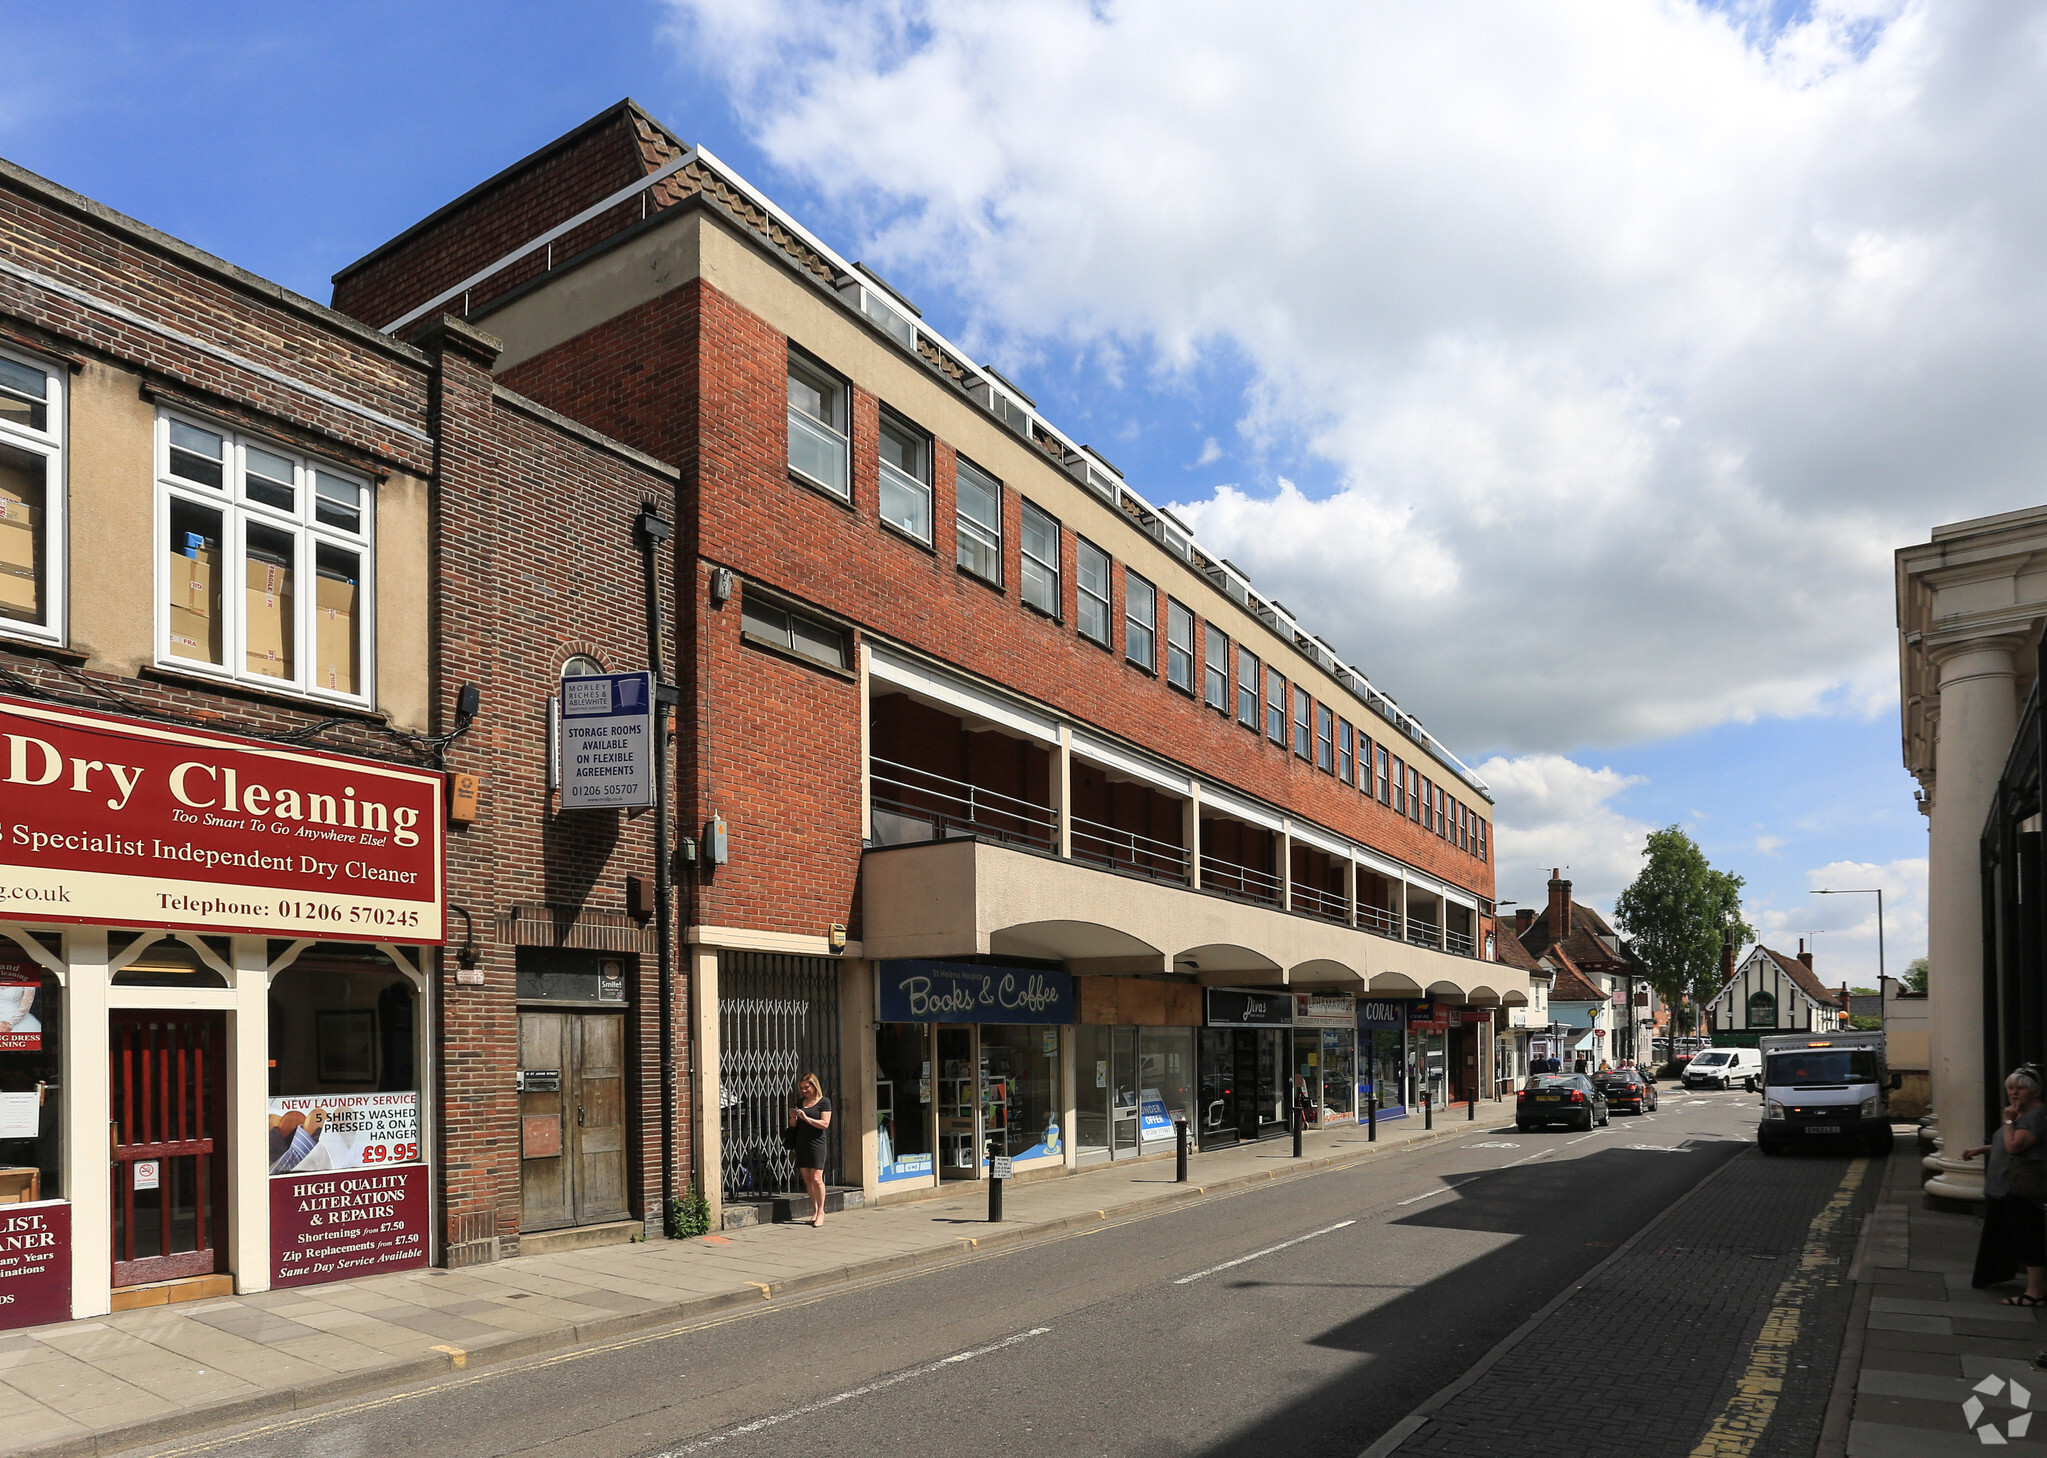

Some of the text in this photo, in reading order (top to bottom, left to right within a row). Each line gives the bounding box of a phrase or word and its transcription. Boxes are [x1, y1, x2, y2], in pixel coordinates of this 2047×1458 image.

[183, 638, 197, 647] FRA
[569, 683, 606, 692] MORLEY
[569, 698, 607, 706] ABLEWHITE
[568, 725, 642, 738] STORAGE ROOMS
[582, 739, 628, 750] AVAILABLE
[576, 752, 634, 764] ON FLEXIBLE
[576, 765, 634, 777] AGREEMENTS
[2, 733, 420, 848] Dry Cleaning
[572, 784, 638, 796] 01206 505707
[172, 808, 387, 848] Too Smart To Go Anywhere Else!
[13, 824, 145, 857] Specialist
[152, 839, 294, 872] Independent
[300, 856, 338, 880] Dry
[345, 861, 417, 884] Cleaner
[157, 892, 419, 927] Telephone: 01206 570245
[932, 969, 984, 980] St Helena Hospice
[601, 980, 622, 988] Smile!
[899, 973, 1059, 1015] Books & Coffee
[1242, 996, 1267, 1021] Divas
[1366, 1002, 1394, 1021] CORAL
[11, 1034, 41, 1042] DRESS
[281, 1094, 417, 1110] NEW LAUNDRY SERVICE
[315, 1107, 416, 1122] 5 SHIRTS WASHED
[1145, 1115, 1165, 1125] OFFER
[324, 1118, 417, 1133] PRESSED & ON A
[369, 1128, 417, 1141] HANGER
[362, 1142, 417, 1164] £9.95
[293, 1174, 408, 1198] HIGH QUALITY
[298, 1189, 405, 1213] ALTERATIONS
[310, 1205, 394, 1226] & REPAIRS
[297, 1219, 405, 1245] Shortenings from £7.50
[282, 1233, 420, 1264] Zip Replacements from £7.50
[24, 1252, 55, 1262] Years
[278, 1245, 423, 1278] Same Day Service Available
